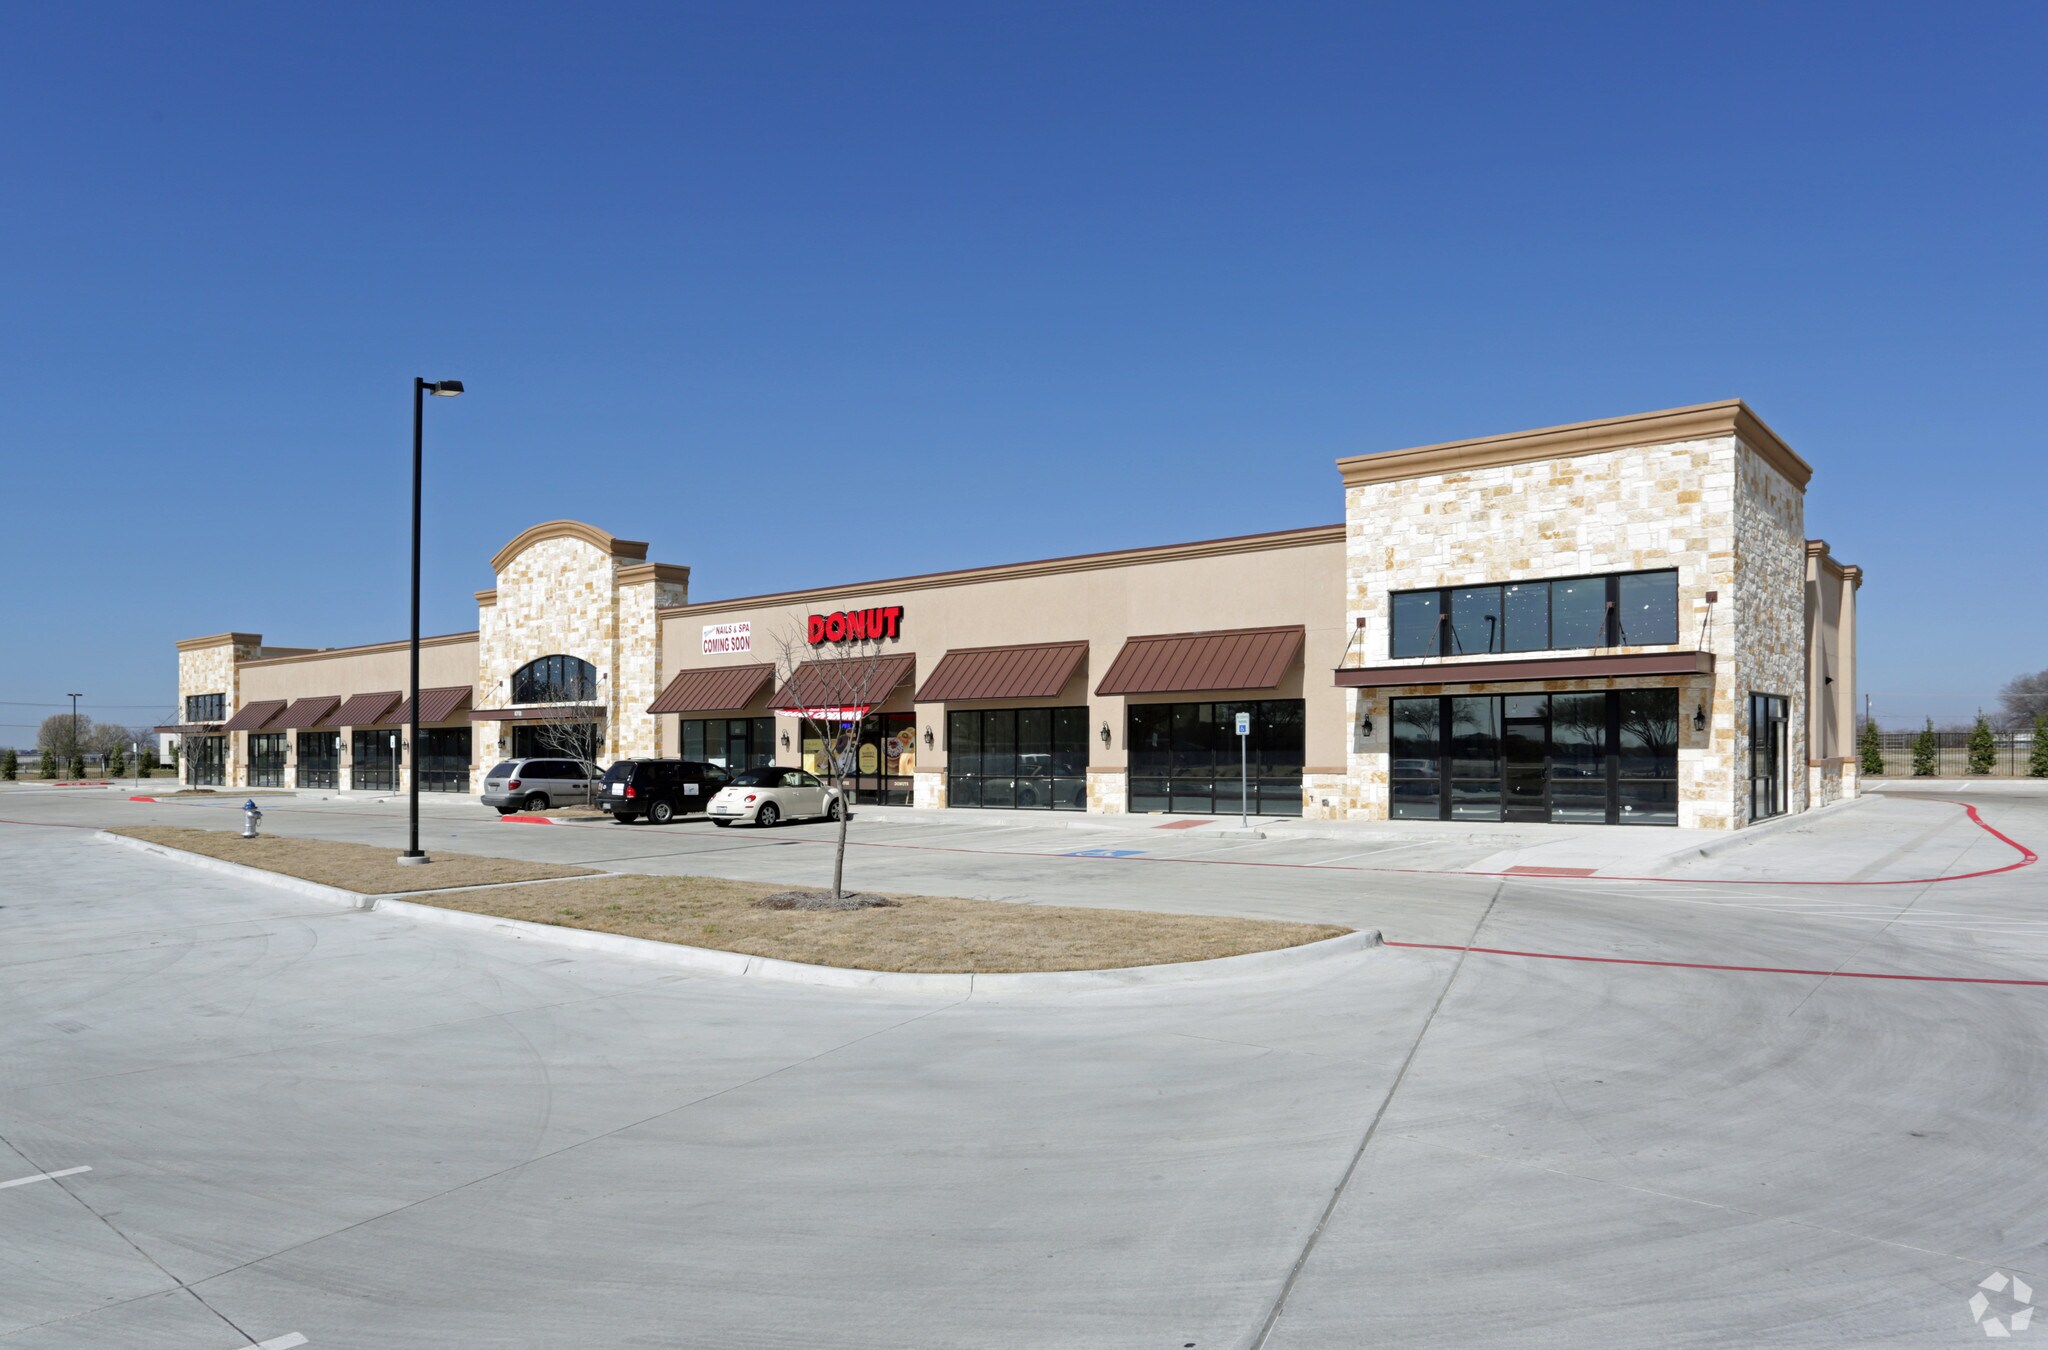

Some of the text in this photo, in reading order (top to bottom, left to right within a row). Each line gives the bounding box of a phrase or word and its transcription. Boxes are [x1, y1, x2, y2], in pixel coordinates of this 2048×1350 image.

[716, 625, 732, 635] NAILS
[739, 623, 750, 633] SPA
[808, 606, 903, 644] DONUT
[703, 635, 750, 653] COMING SOON
